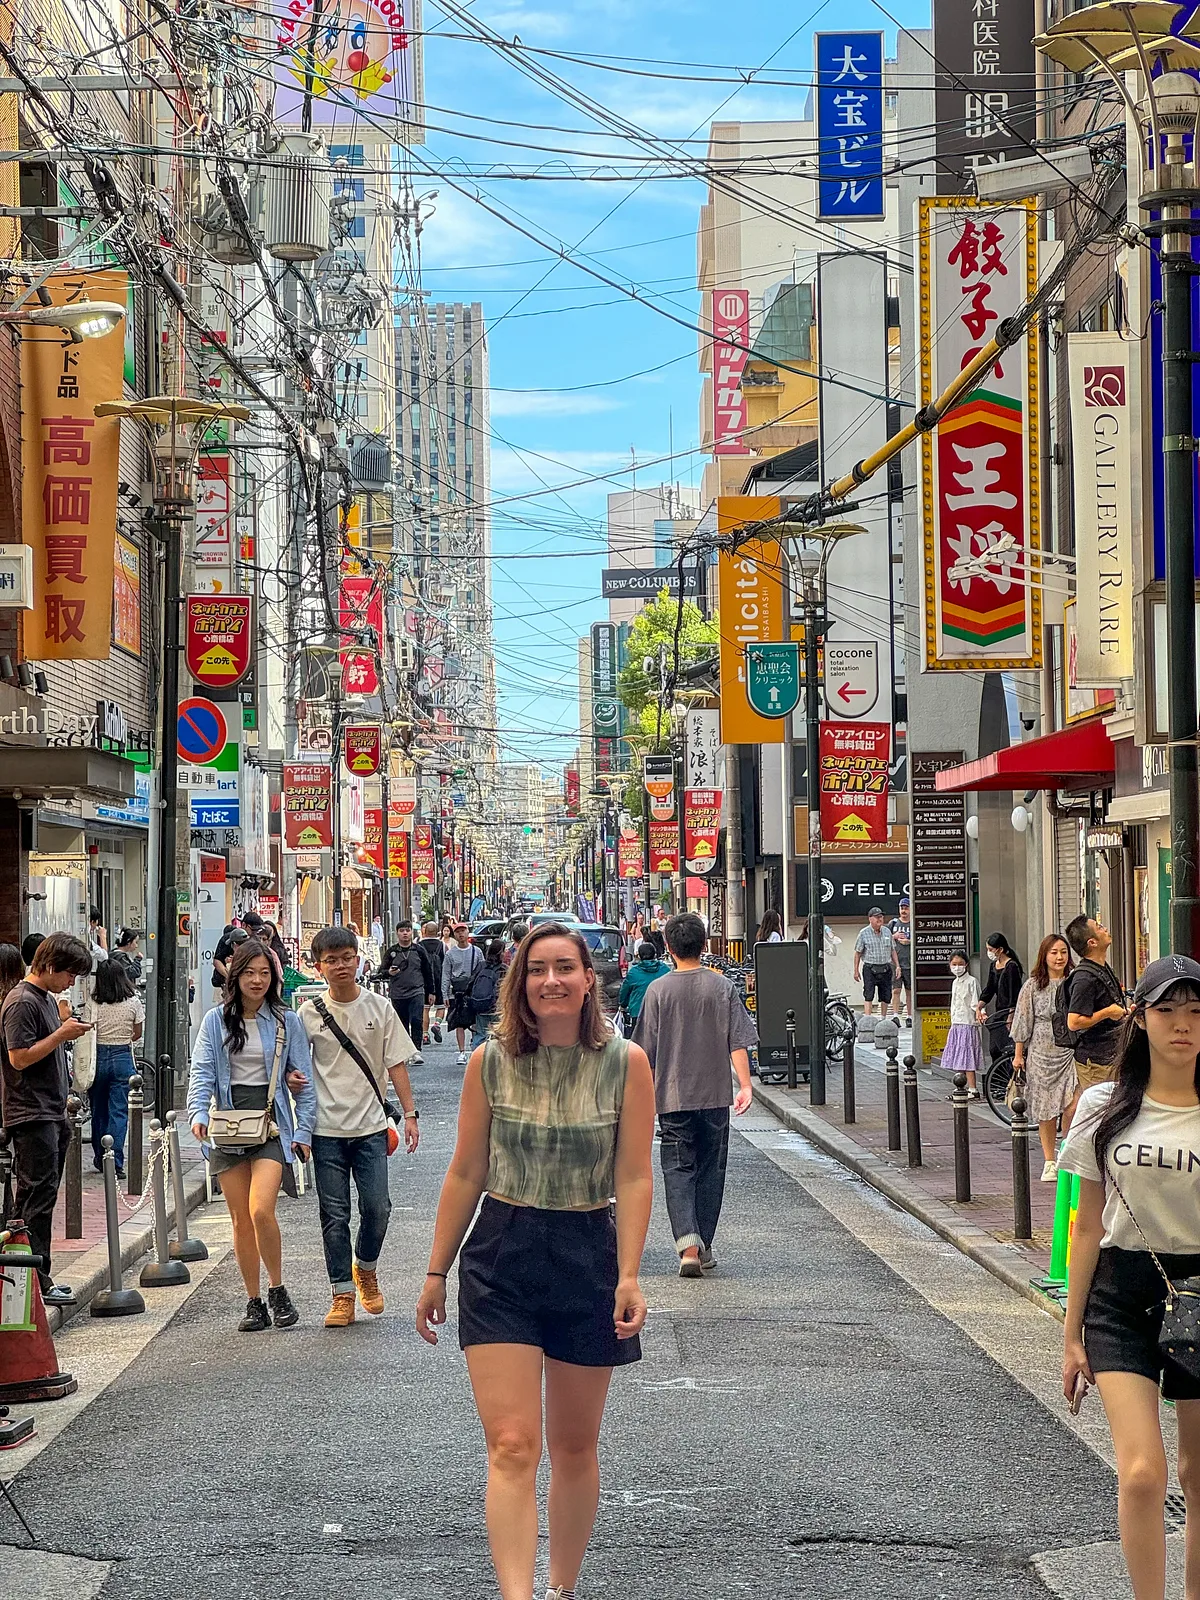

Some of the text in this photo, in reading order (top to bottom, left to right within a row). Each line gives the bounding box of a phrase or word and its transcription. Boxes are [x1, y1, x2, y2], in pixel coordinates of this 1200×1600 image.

[277, 0, 313, 49] KAR
[831, 44, 869, 206] 大宝ビル
[717, 324, 743, 446] ネットカフェ
[41, 414, 95, 643] 高価買取
[1094, 413, 1122, 656] GALLERY RARE
[606, 576, 697, 589] NEW COLUMBUS
[191, 603, 248, 616] ネットカフェ
[194, 616, 244, 635] ポパイ
[203, 635, 235, 643] 心斎橋店
[206, 656, 230, 665] この先
[829, 649, 873, 659] cocone
[756, 661, 792, 676] 恵聖会
[754, 676, 794, 685] クリニック
[824, 728, 886, 740] ヘアアイロン
[350, 738, 376, 748] ポパイ
[834, 740, 875, 751] 無料貸出
[821, 755, 888, 771] ネットカフェ
[286, 767, 328, 775] ヘアアイロン
[178, 771, 216, 785] 自動車
[821, 771, 887, 794] ポパイ
[286, 786, 329, 796] ネットカフェ
[286, 797, 329, 812] ポパイ
[830, 794, 877, 807] 心斎橋店
[202, 811, 230, 824] たばこ
[292, 812, 324, 821] 心斎橋店
[686, 816, 719, 829] ポパイ
[842, 823, 864, 832] この先
